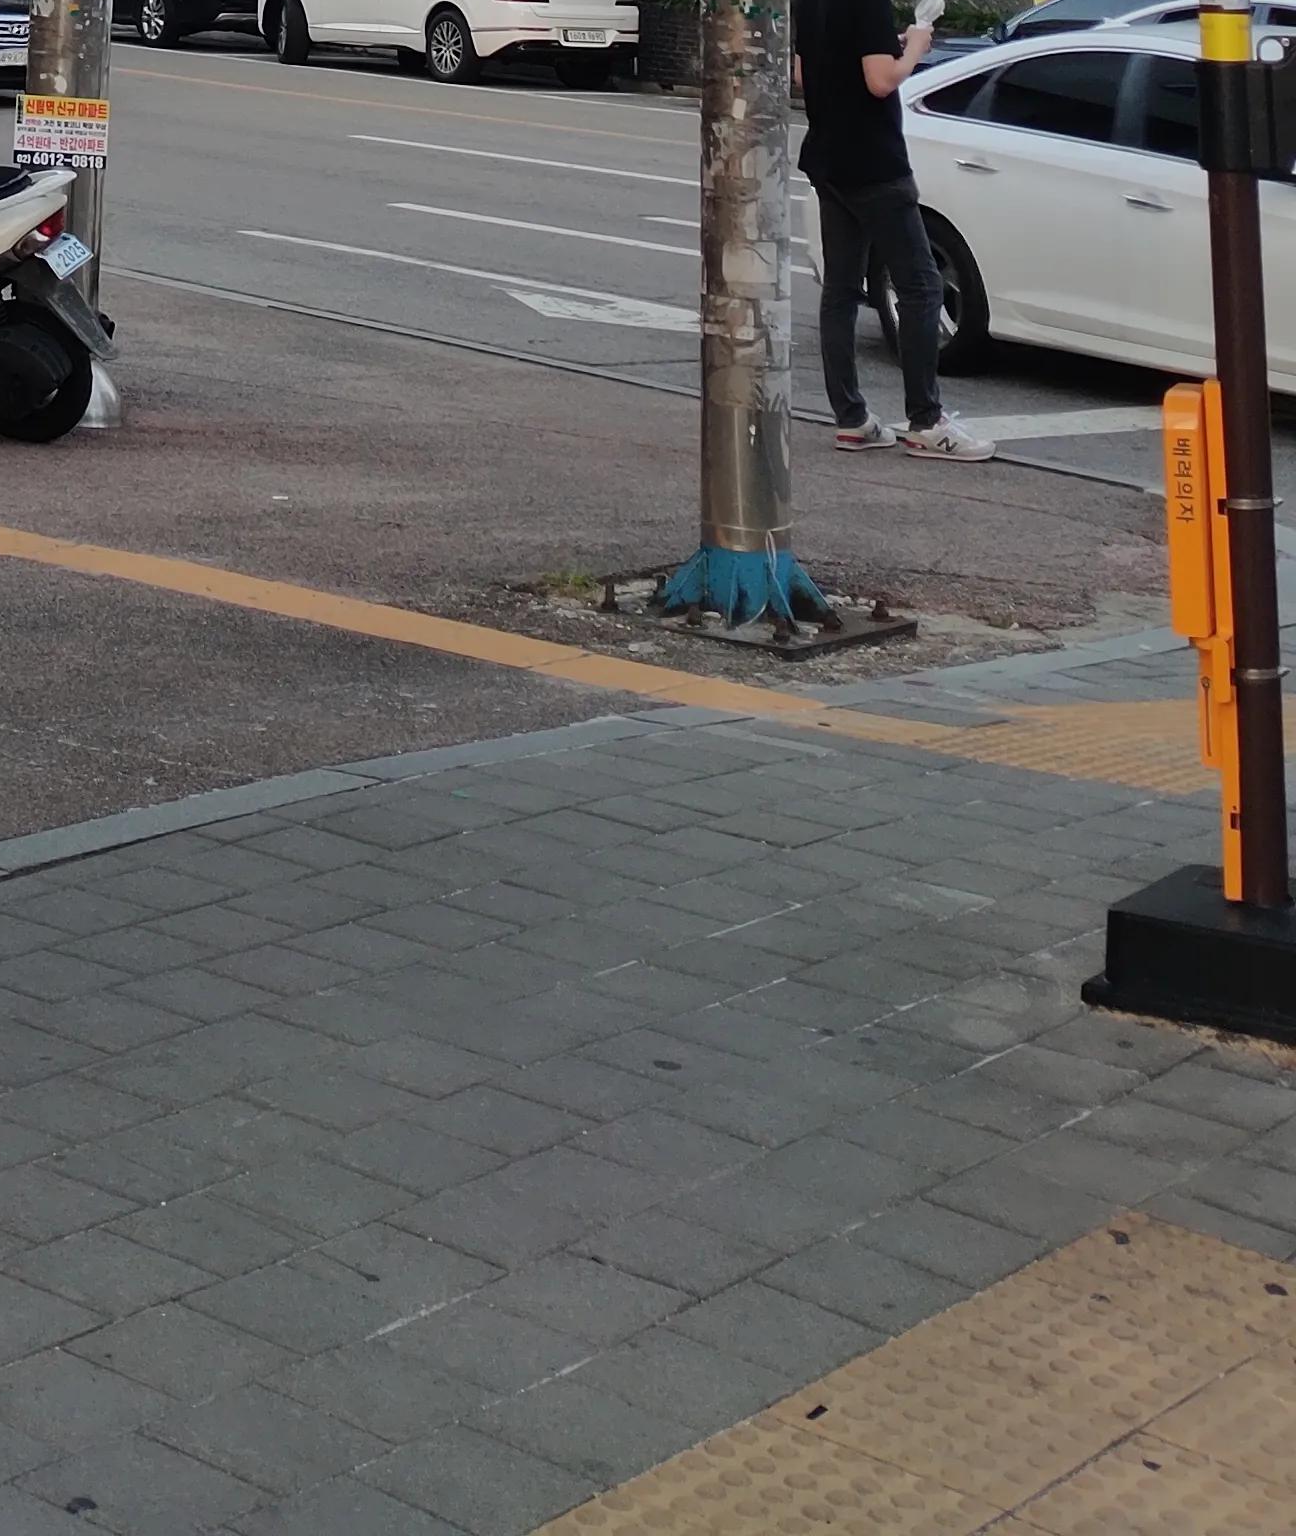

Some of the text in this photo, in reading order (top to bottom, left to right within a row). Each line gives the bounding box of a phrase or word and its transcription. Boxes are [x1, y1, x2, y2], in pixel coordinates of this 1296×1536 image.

[57, 101, 76, 116] 신규
[78, 102, 108, 119] 아파트
[17, 152, 104, 169] 02) 6012-0818
[57, 241, 86, 268] 2025
[1172, 437, 1195, 524] 배려의자
